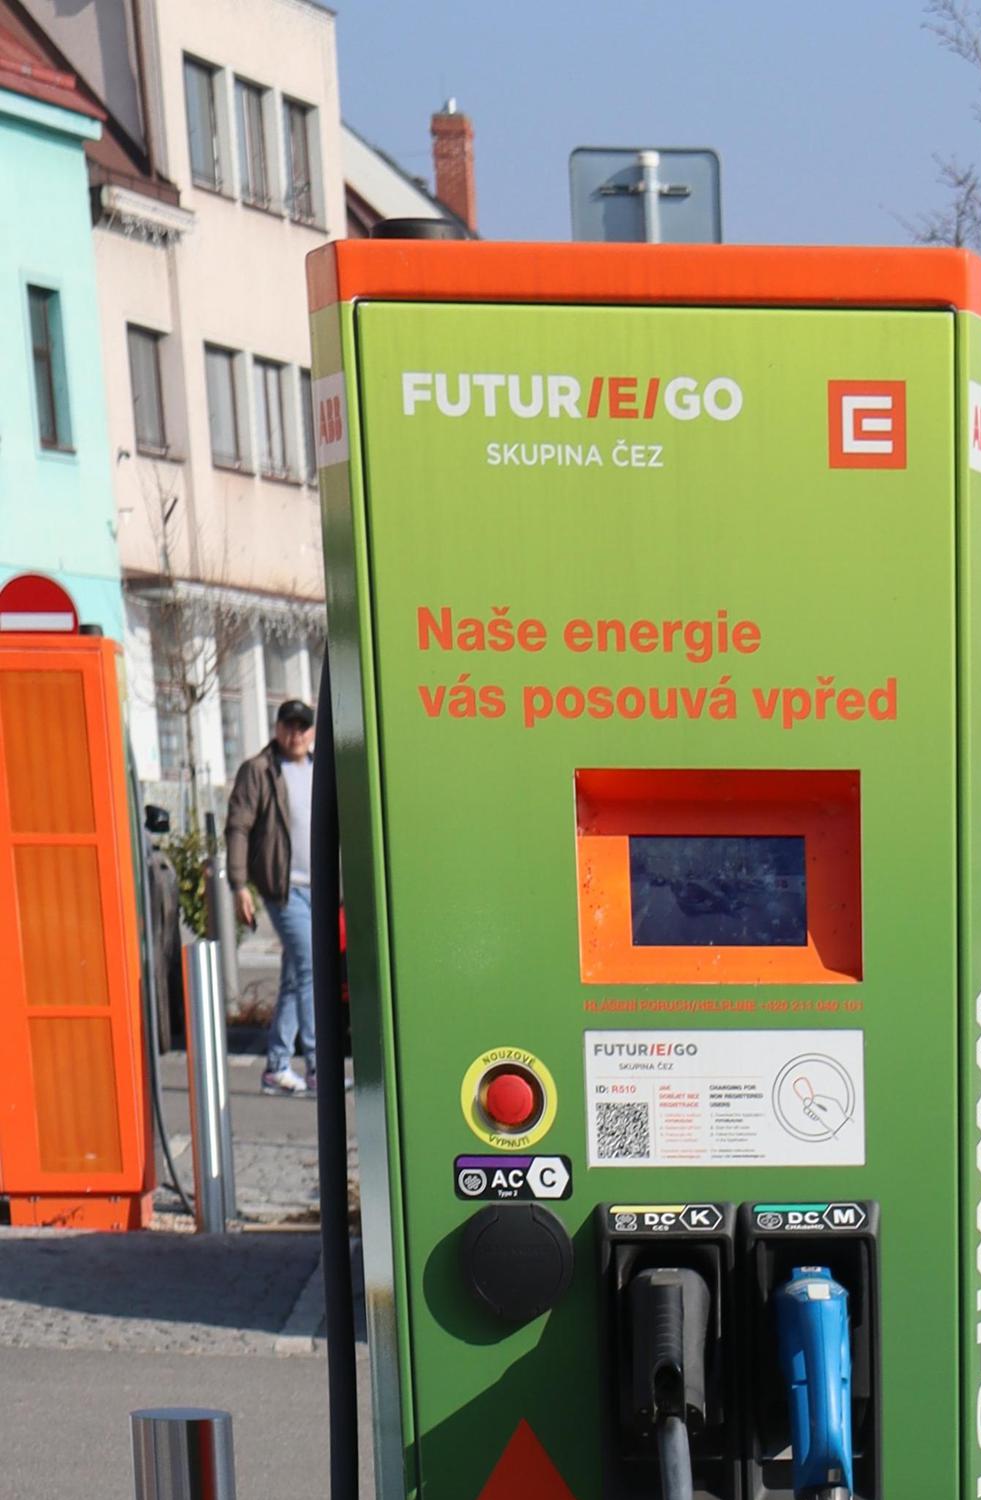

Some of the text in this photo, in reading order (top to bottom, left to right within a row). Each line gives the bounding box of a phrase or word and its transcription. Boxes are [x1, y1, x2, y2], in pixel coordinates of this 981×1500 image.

[320, 396, 342, 446] ABB
[486, 439, 665, 468] SKUPINA ČEZ
[416, 606, 762, 664] Naše energie
[418, 673, 898, 730] vás posouvá vpřed
[618, 1060, 675, 1071] SKUPINA ČEZ
[595, 1084, 637, 1094] ID: R510
[491, 1167, 557, 1189] AC C
[498, 1189, 513, 1198] Type
[644, 1209, 711, 1226] DC K
[788, 1208, 856, 1225] DC M
